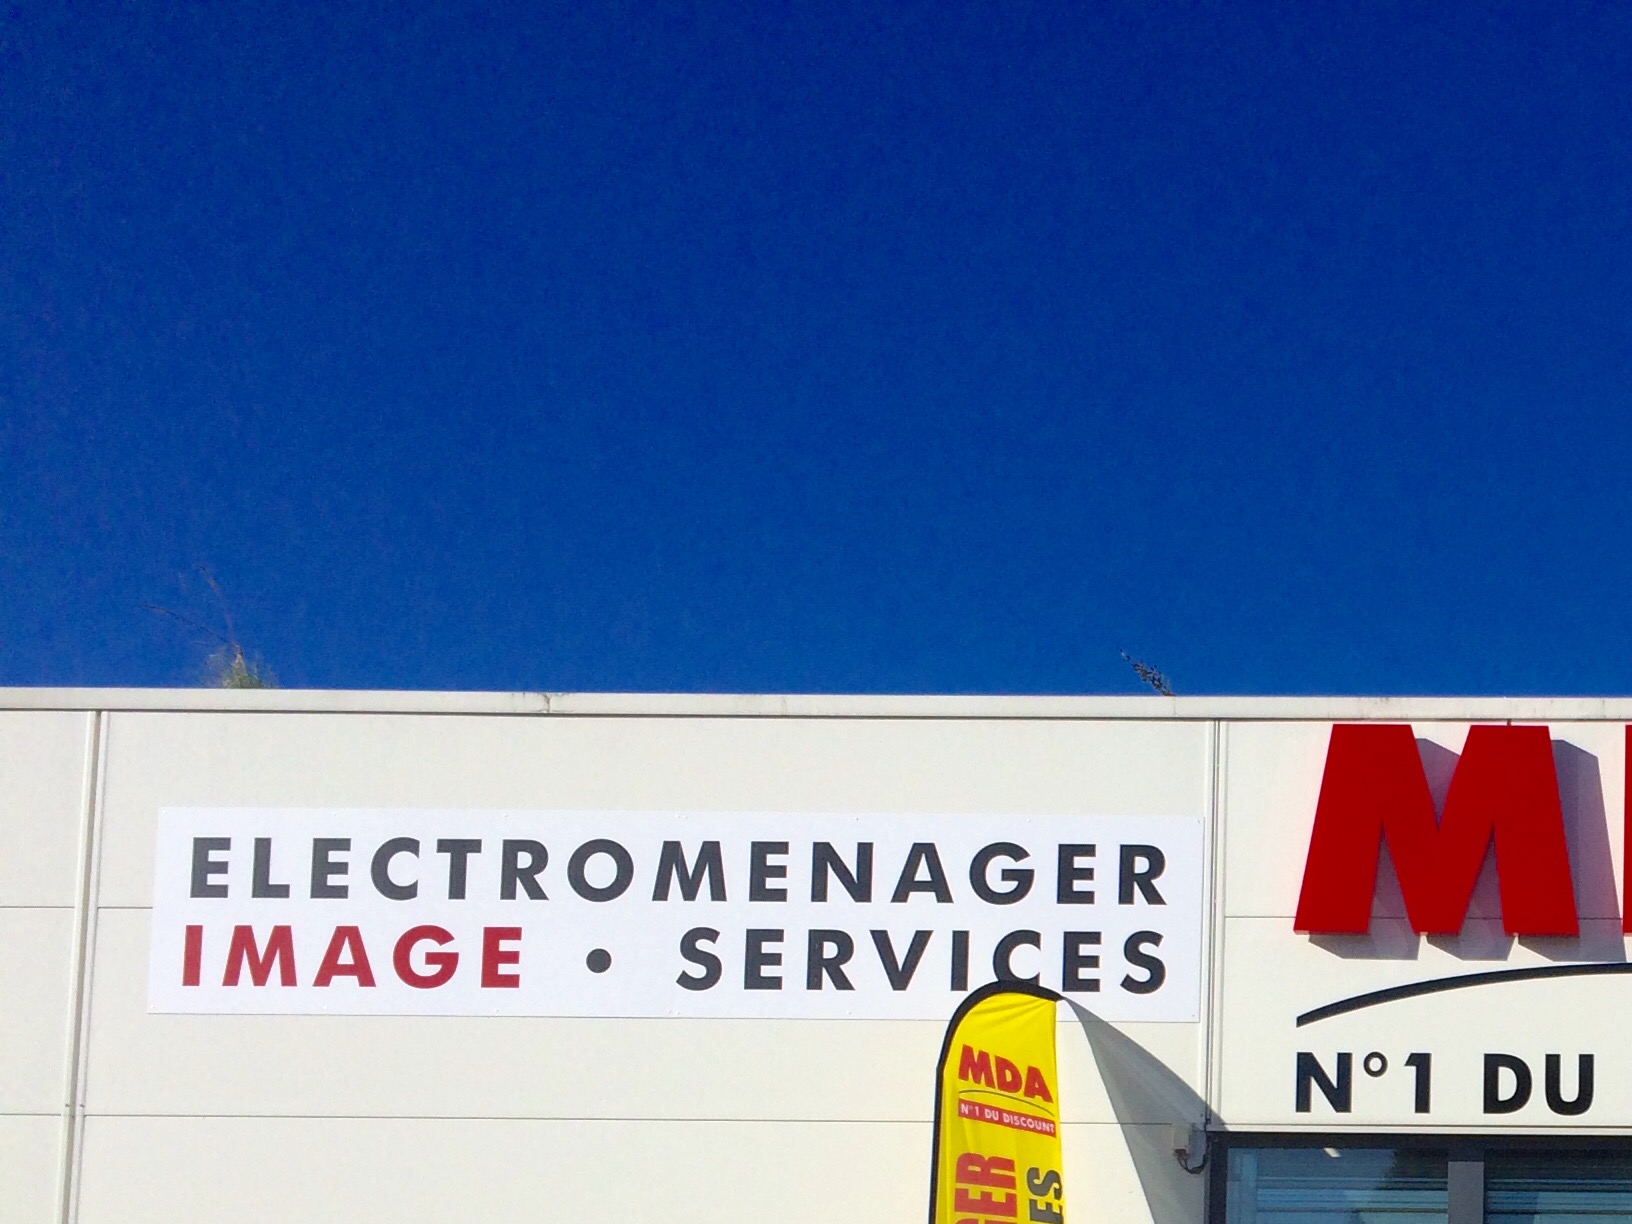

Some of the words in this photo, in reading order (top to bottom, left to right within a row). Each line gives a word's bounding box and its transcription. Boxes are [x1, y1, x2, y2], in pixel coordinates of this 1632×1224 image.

[190, 835, 1168, 906] ELECTROMENAGER
[181, 923, 523, 989] IMAGE
[675, 927, 1167, 993] SERVICES
[958, 1043, 1054, 1104] MDA
[1294, 1051, 1431, 1114] N°1
[1483, 1053, 1595, 1116] DU
[984, 1107, 1000, 1121] DU
[1002, 1112, 1055, 1134] DISCOUNT
